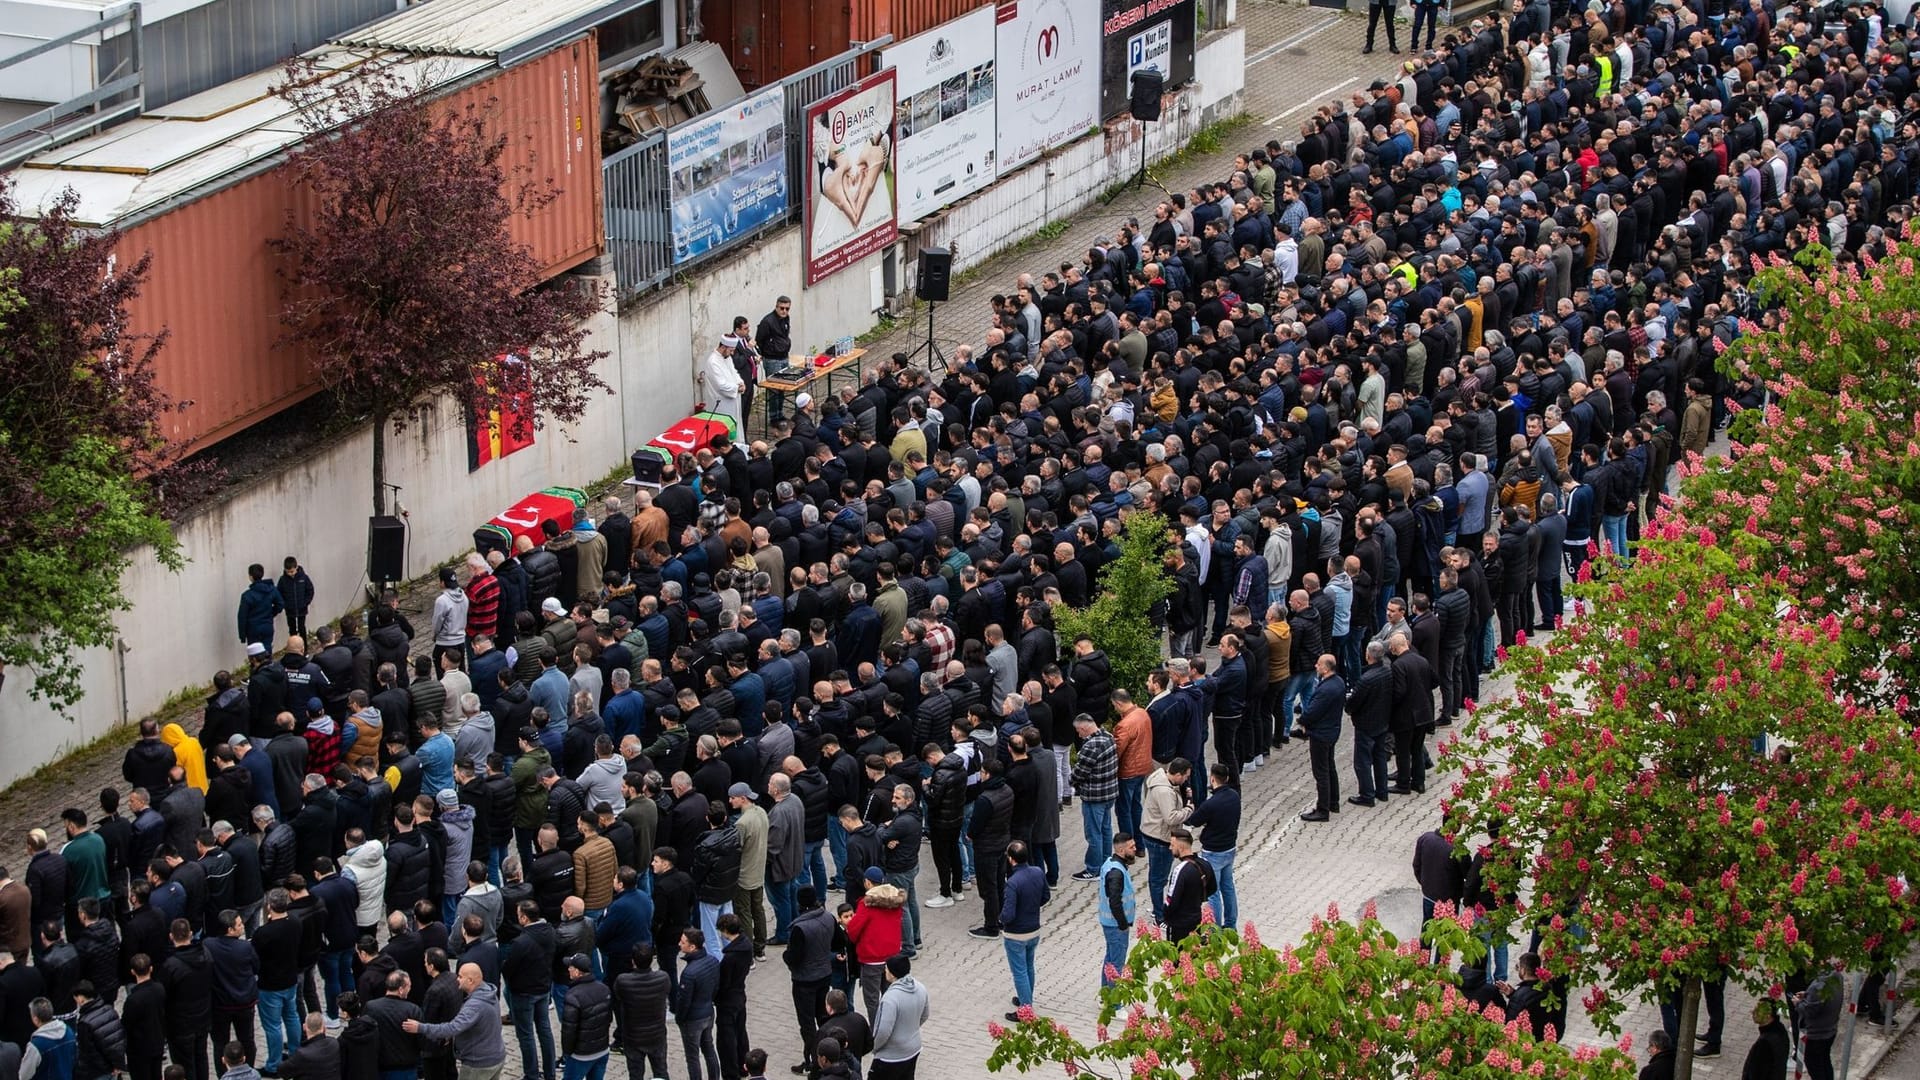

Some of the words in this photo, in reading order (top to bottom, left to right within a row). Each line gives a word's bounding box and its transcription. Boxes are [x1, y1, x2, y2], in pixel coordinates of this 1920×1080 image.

[1103, 4, 1145, 36] KÖSEM
[1145, 32, 1157, 46] Nur
[1158, 25, 1168, 40] für
[1132, 41, 1141, 64] P
[1145, 41, 1169, 61] Kunden
[1016, 79, 1049, 102] MURAT
[1053, 65, 1081, 85] LAMM
[847, 105, 875, 128] BAYAR
[670, 121, 722, 150] Hochdruckreinigung
[670, 150, 684, 167] ganz
[685, 143, 699, 159] ohne
[732, 184, 749, 201] Schont
[748, 194, 757, 207] den
[876, 225, 892, 238] Konzerte
